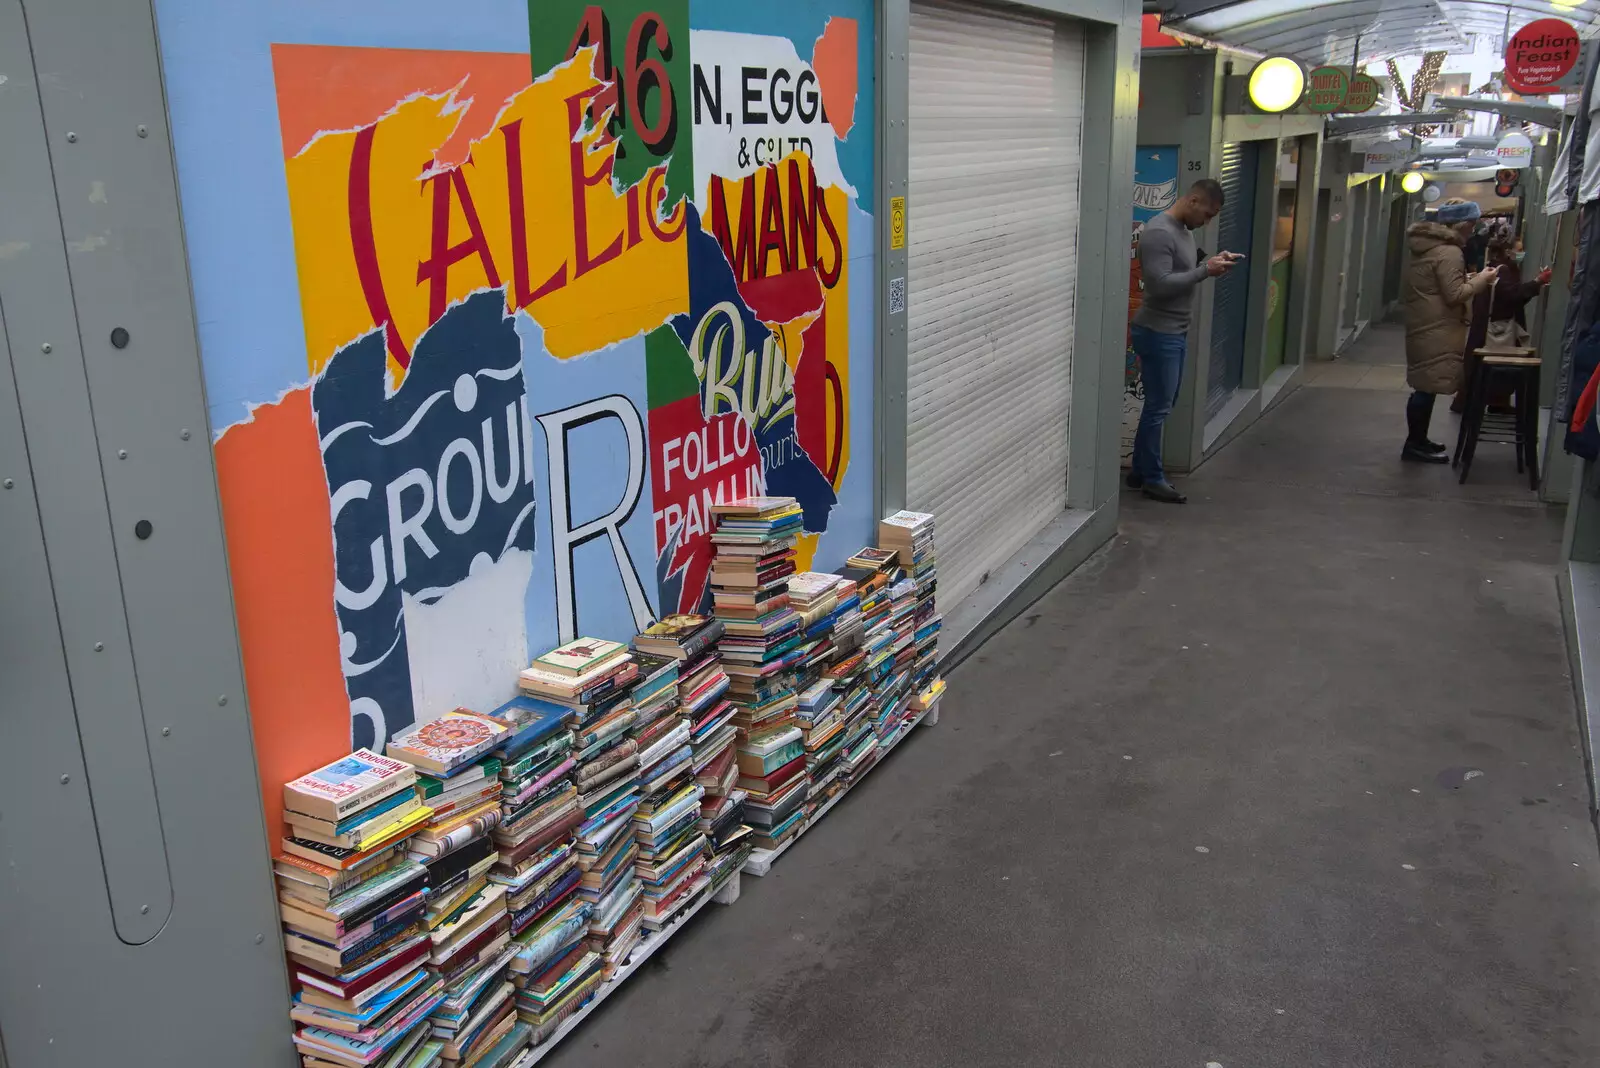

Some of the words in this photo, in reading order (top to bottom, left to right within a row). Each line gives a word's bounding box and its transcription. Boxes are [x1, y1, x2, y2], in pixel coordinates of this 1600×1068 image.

[1512, 34, 1578, 49] Indian
[1516, 50, 1570, 62] Feast
[1529, 66, 1555, 74] Vegetarian
[737, 136, 751, 169] &
[1497, 147, 1531, 156] FRESH
[1187, 160, 1202, 171] 35
[535, 393, 660, 648] R
[355, 750, 408, 772] MURDOCH
[369, 767, 396, 778] IRIS
[345, 798, 360, 810] MURDOCH
